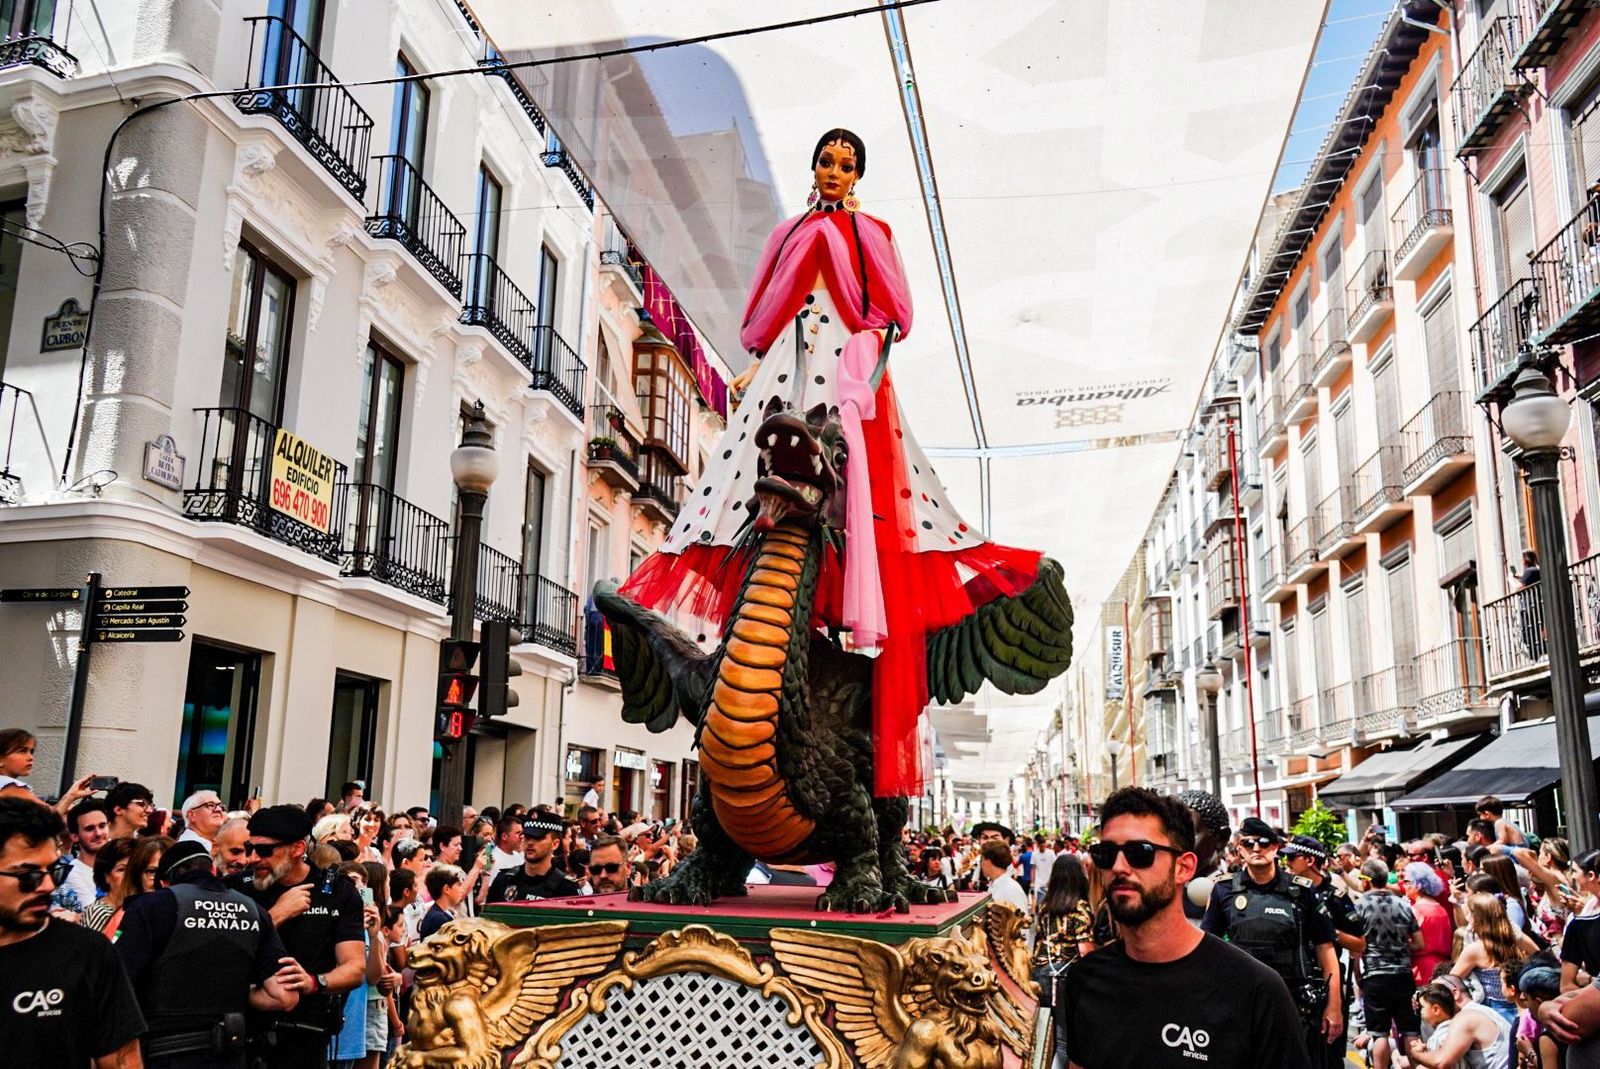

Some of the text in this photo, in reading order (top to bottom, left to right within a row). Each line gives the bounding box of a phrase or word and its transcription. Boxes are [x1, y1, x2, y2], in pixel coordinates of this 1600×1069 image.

[1015, 383, 1174, 406] Alhambra
[277, 432, 332, 483] ALQUILER
[286, 466, 319, 496] EDIFICIO
[273, 478, 328, 530] 696 470 900
[113, 589, 138, 597] Catedral
[111, 603, 145, 612] Capilla Real
[109, 617, 135, 625] Mercado
[135, 617, 147, 625] San
[1112, 630, 1123, 686] ALQUISUR
[194, 900, 249, 913] POLICIA
[303, 906, 329, 915] LICÍA
[208, 911, 238, 920] LOCAL
[184, 917, 261, 932] GRANADA
[1182, 1050, 1209, 1062] servicios
